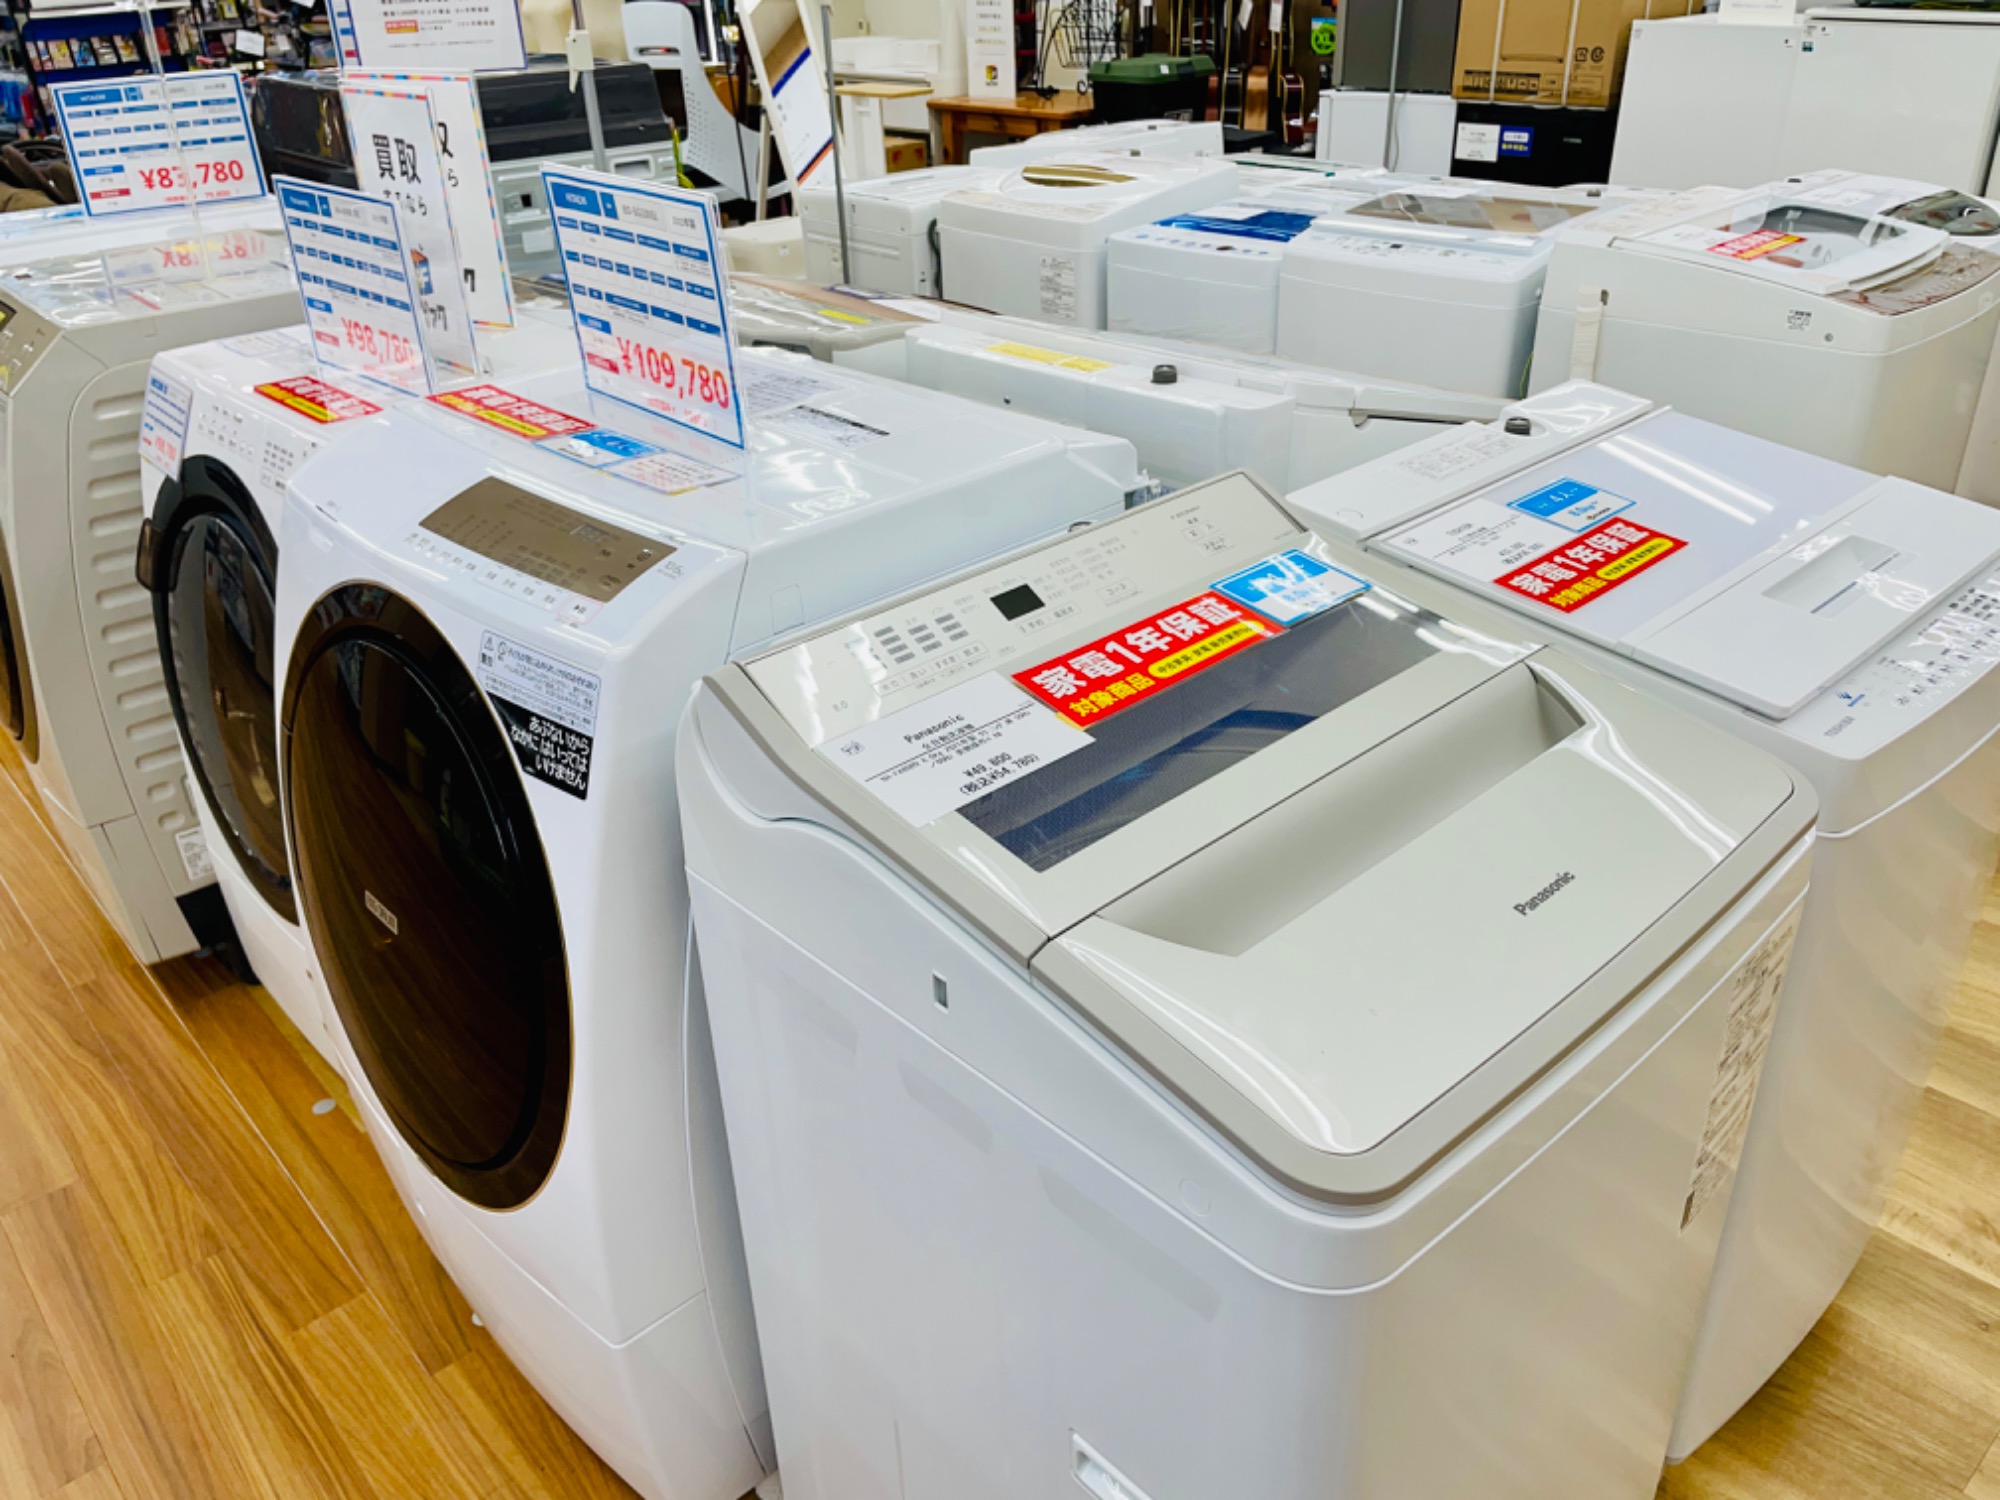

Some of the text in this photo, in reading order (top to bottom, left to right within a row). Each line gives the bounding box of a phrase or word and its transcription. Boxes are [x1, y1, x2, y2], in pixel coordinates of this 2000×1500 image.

[372, 133, 421, 184] 買取
[616, 336, 730, 410] ¥109,780
[1508, 522, 1651, 597] 家電1年保証
[1031, 596, 1244, 699] 家電1年保証
[1069, 673, 1155, 718] 対象商品
[528, 715, 591, 755] あぶないから
[903, 713, 965, 744] Panasonic
[535, 755, 587, 791] いけません
[962, 751, 1012, 778] ¥49,800
[1512, 871, 1575, 918] Panasonic
